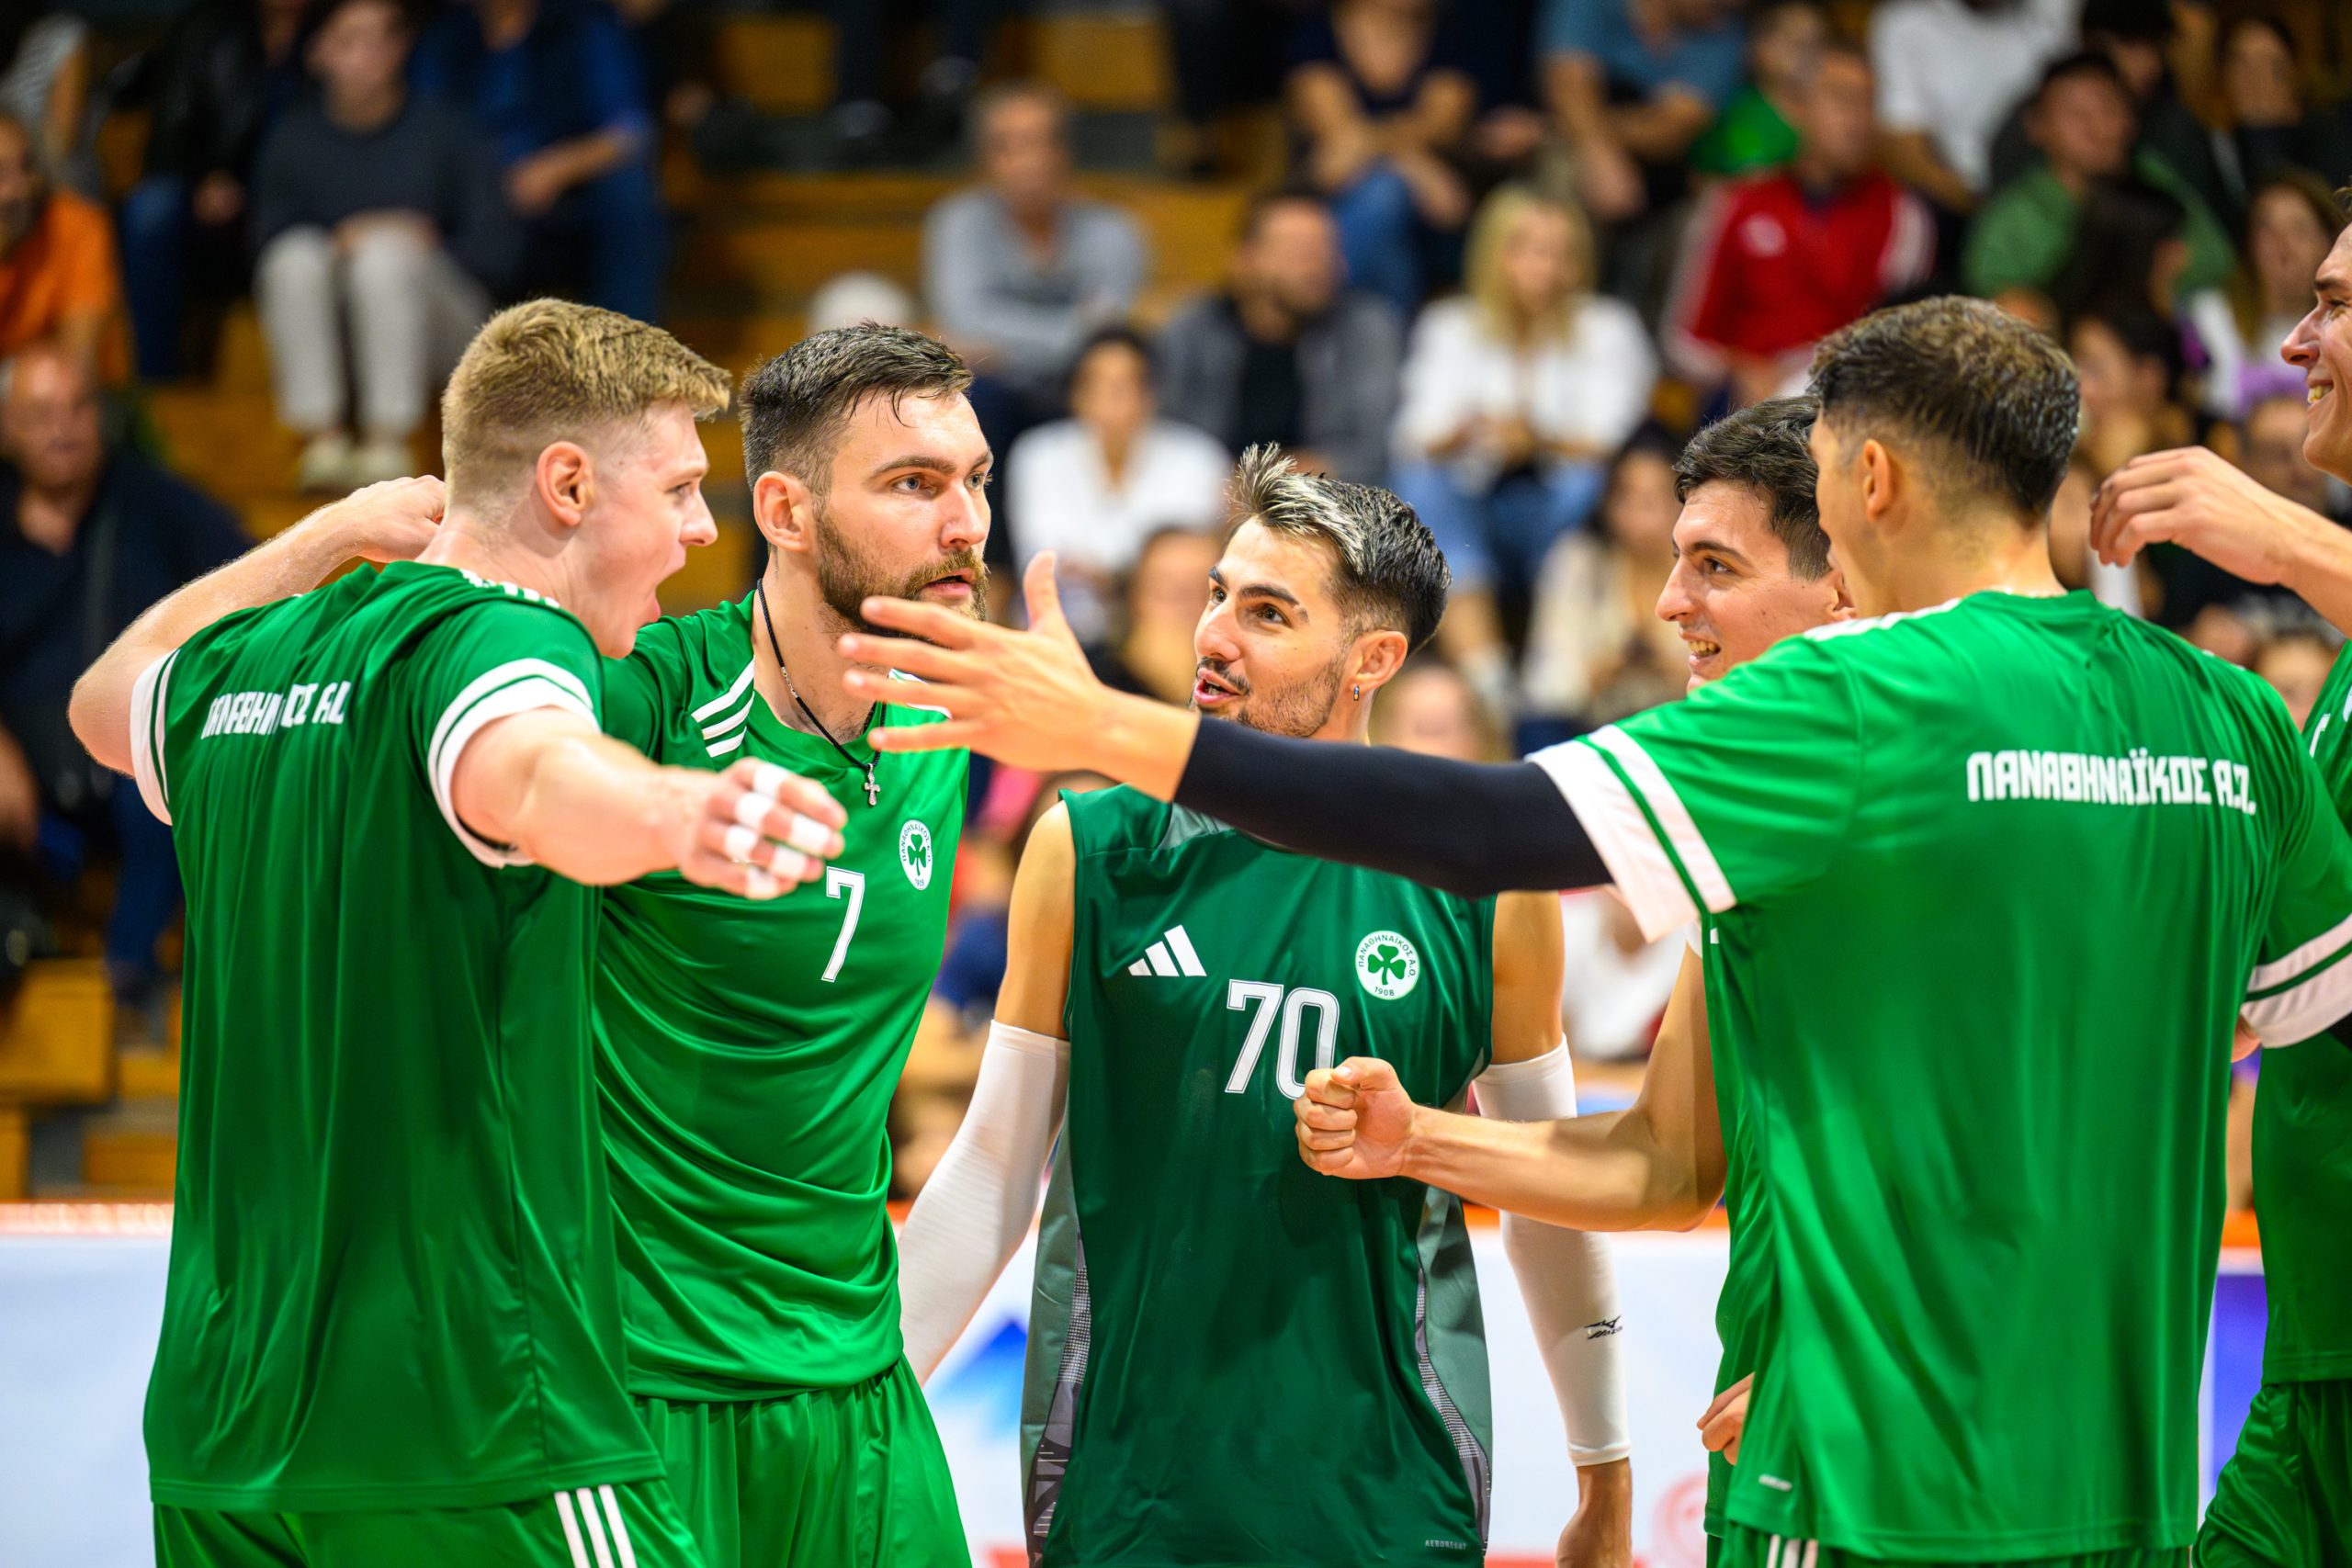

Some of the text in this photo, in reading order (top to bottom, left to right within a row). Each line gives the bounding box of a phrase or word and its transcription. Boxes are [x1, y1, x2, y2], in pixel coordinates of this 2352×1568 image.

[1966, 747, 2212, 806] ΠΑΝΑΘΗΝΑΪΚΟΣ
[821, 866, 865, 983] 7
[1374, 987, 1395, 997] 1908
[1225, 978, 1340, 1100] 70
